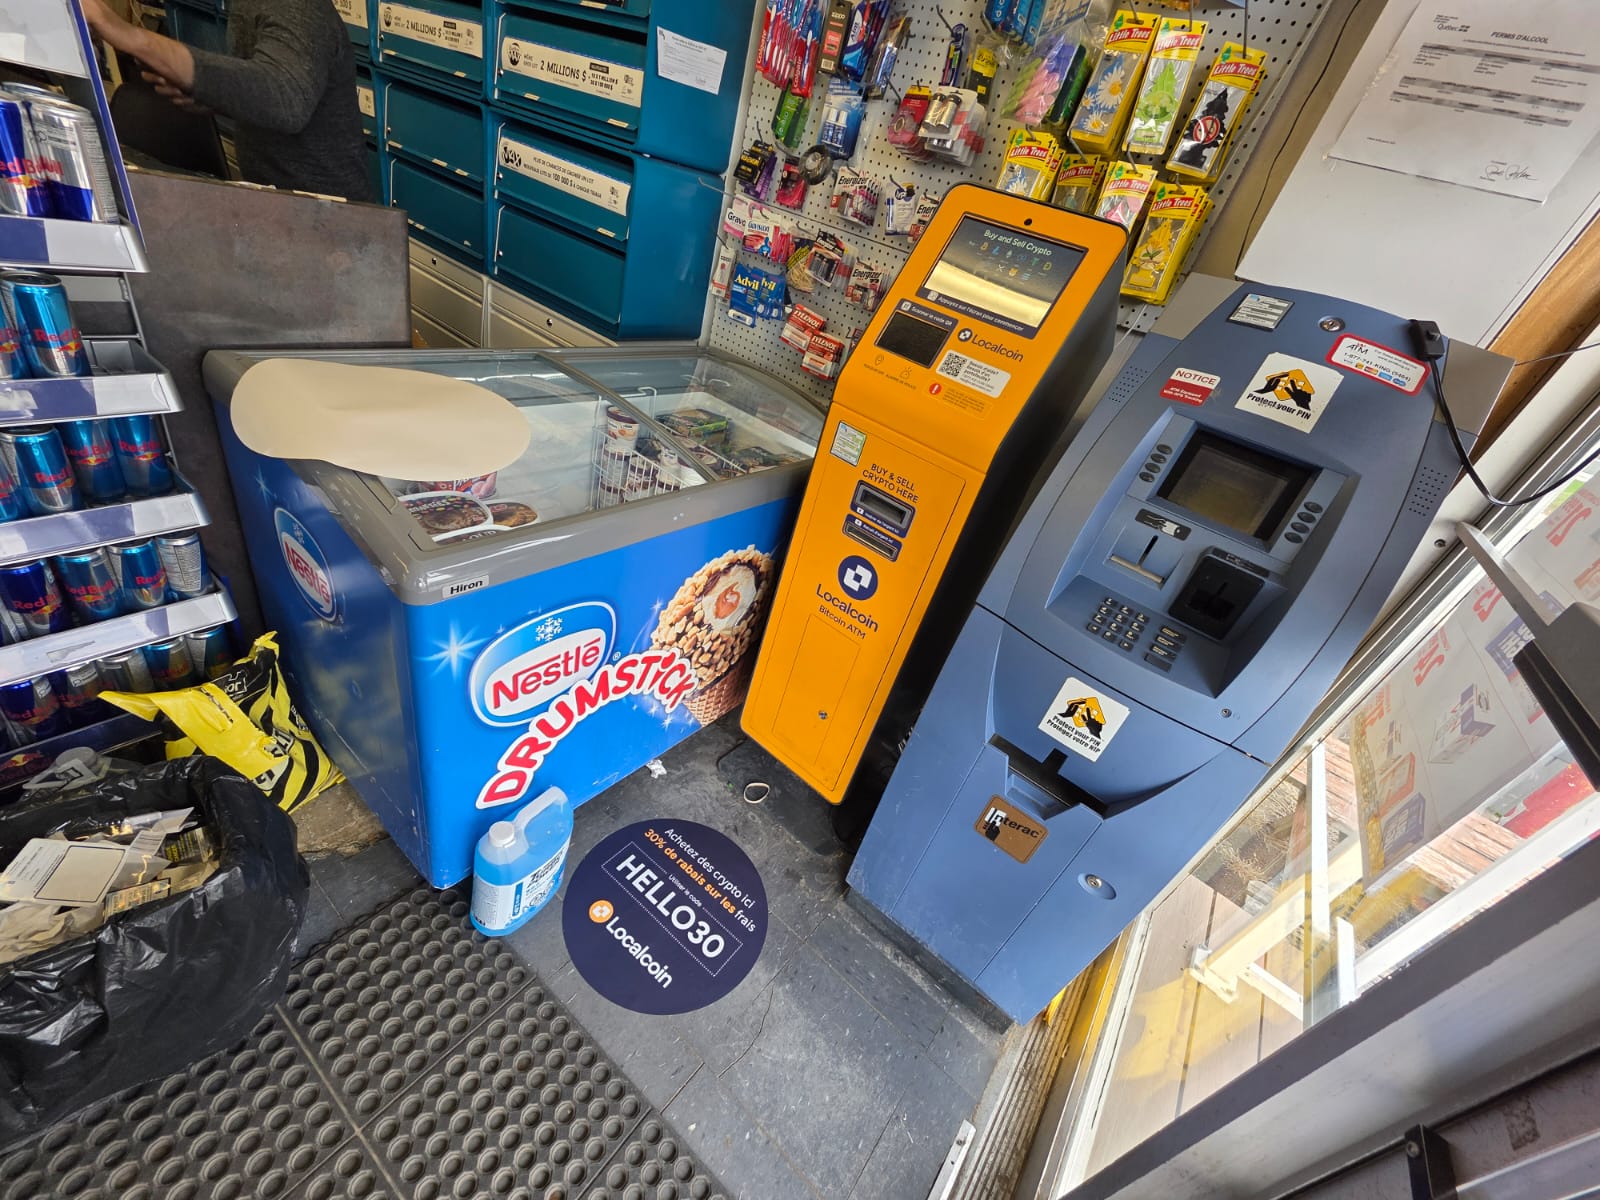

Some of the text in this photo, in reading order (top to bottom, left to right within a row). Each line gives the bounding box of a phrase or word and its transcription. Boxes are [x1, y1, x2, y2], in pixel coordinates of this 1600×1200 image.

[406, 20, 410, 30] 2
[411, 21, 437, 36] MILLIONS
[1108, 28, 1150, 42] Little Trees
[758, 30, 767, 64] Colgate
[1178, 34, 1200, 48] Trees
[540, 60, 545, 71] 2
[546, 60, 580, 80] MILLIONS
[582, 70, 587, 83] $
[1214, 62, 1259, 77] Little Trees
[1009, 146, 1048, 159] Little Trees
[838, 174, 869, 186] Energizer
[1076, 166, 1094, 178] Trees
[1151, 198, 1193, 212] Little Trees
[984, 229, 1052, 257] Buy and Sell Crypto
[734, 274, 760, 291] Advil
[852, 268, 883, 280] Energizer
[793, 310, 820, 328] TYLENOL
[812, 335, 838, 351] TYLENOL
[972, 334, 1024, 362] Localcoin
[1345, 343, 1369, 356] ATM
[1176, 368, 1216, 386] NOTICE
[1246, 392, 1312, 420] Protect your PIN
[862, 469, 919, 504] CRYPTO HERE
[870, 464, 916, 492] BUY & SELL
[450, 578, 484, 596] Hiron
[816, 584, 879, 632] Localcoin
[820, 604, 866, 640] Bitcoin ATM
[483, 652, 696, 803] DRUMSTICK
[1052, 715, 1102, 747] Protect your PIN
[1073, 733, 1089, 748] votre
[1089, 744, 1102, 754] NIP
[664, 828, 756, 910] Achetez des crypto ici
[644, 828, 756, 933] 30% de rabais sur les frais
[616, 854, 725, 958] HELLO30
[606, 916, 674, 989] Localcoin
